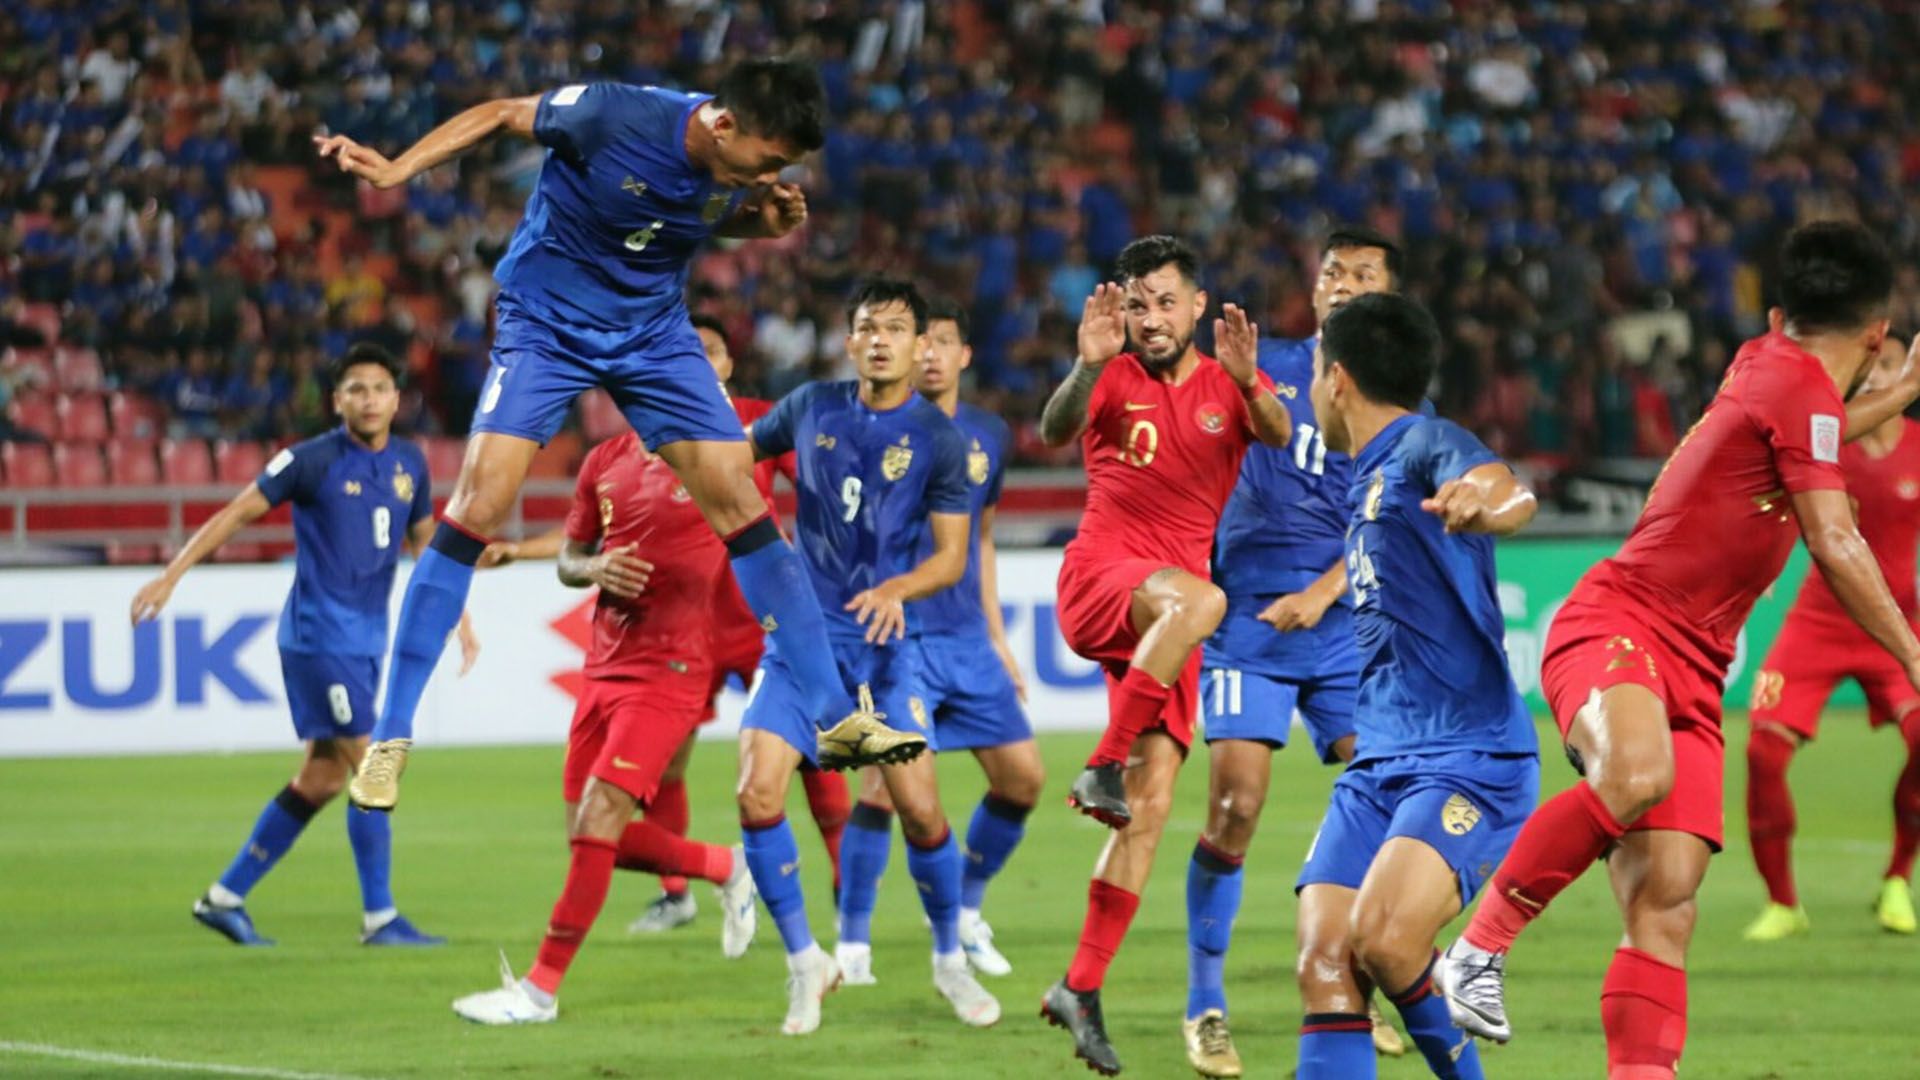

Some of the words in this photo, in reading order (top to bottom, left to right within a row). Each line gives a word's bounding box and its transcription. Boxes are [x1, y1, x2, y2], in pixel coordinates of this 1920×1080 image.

[1295, 423, 1327, 475] 11
[842, 476, 862, 522] 9
[373, 506, 391, 549] 8
[328, 684, 352, 725] 8
[1213, 669, 1242, 716] 11
